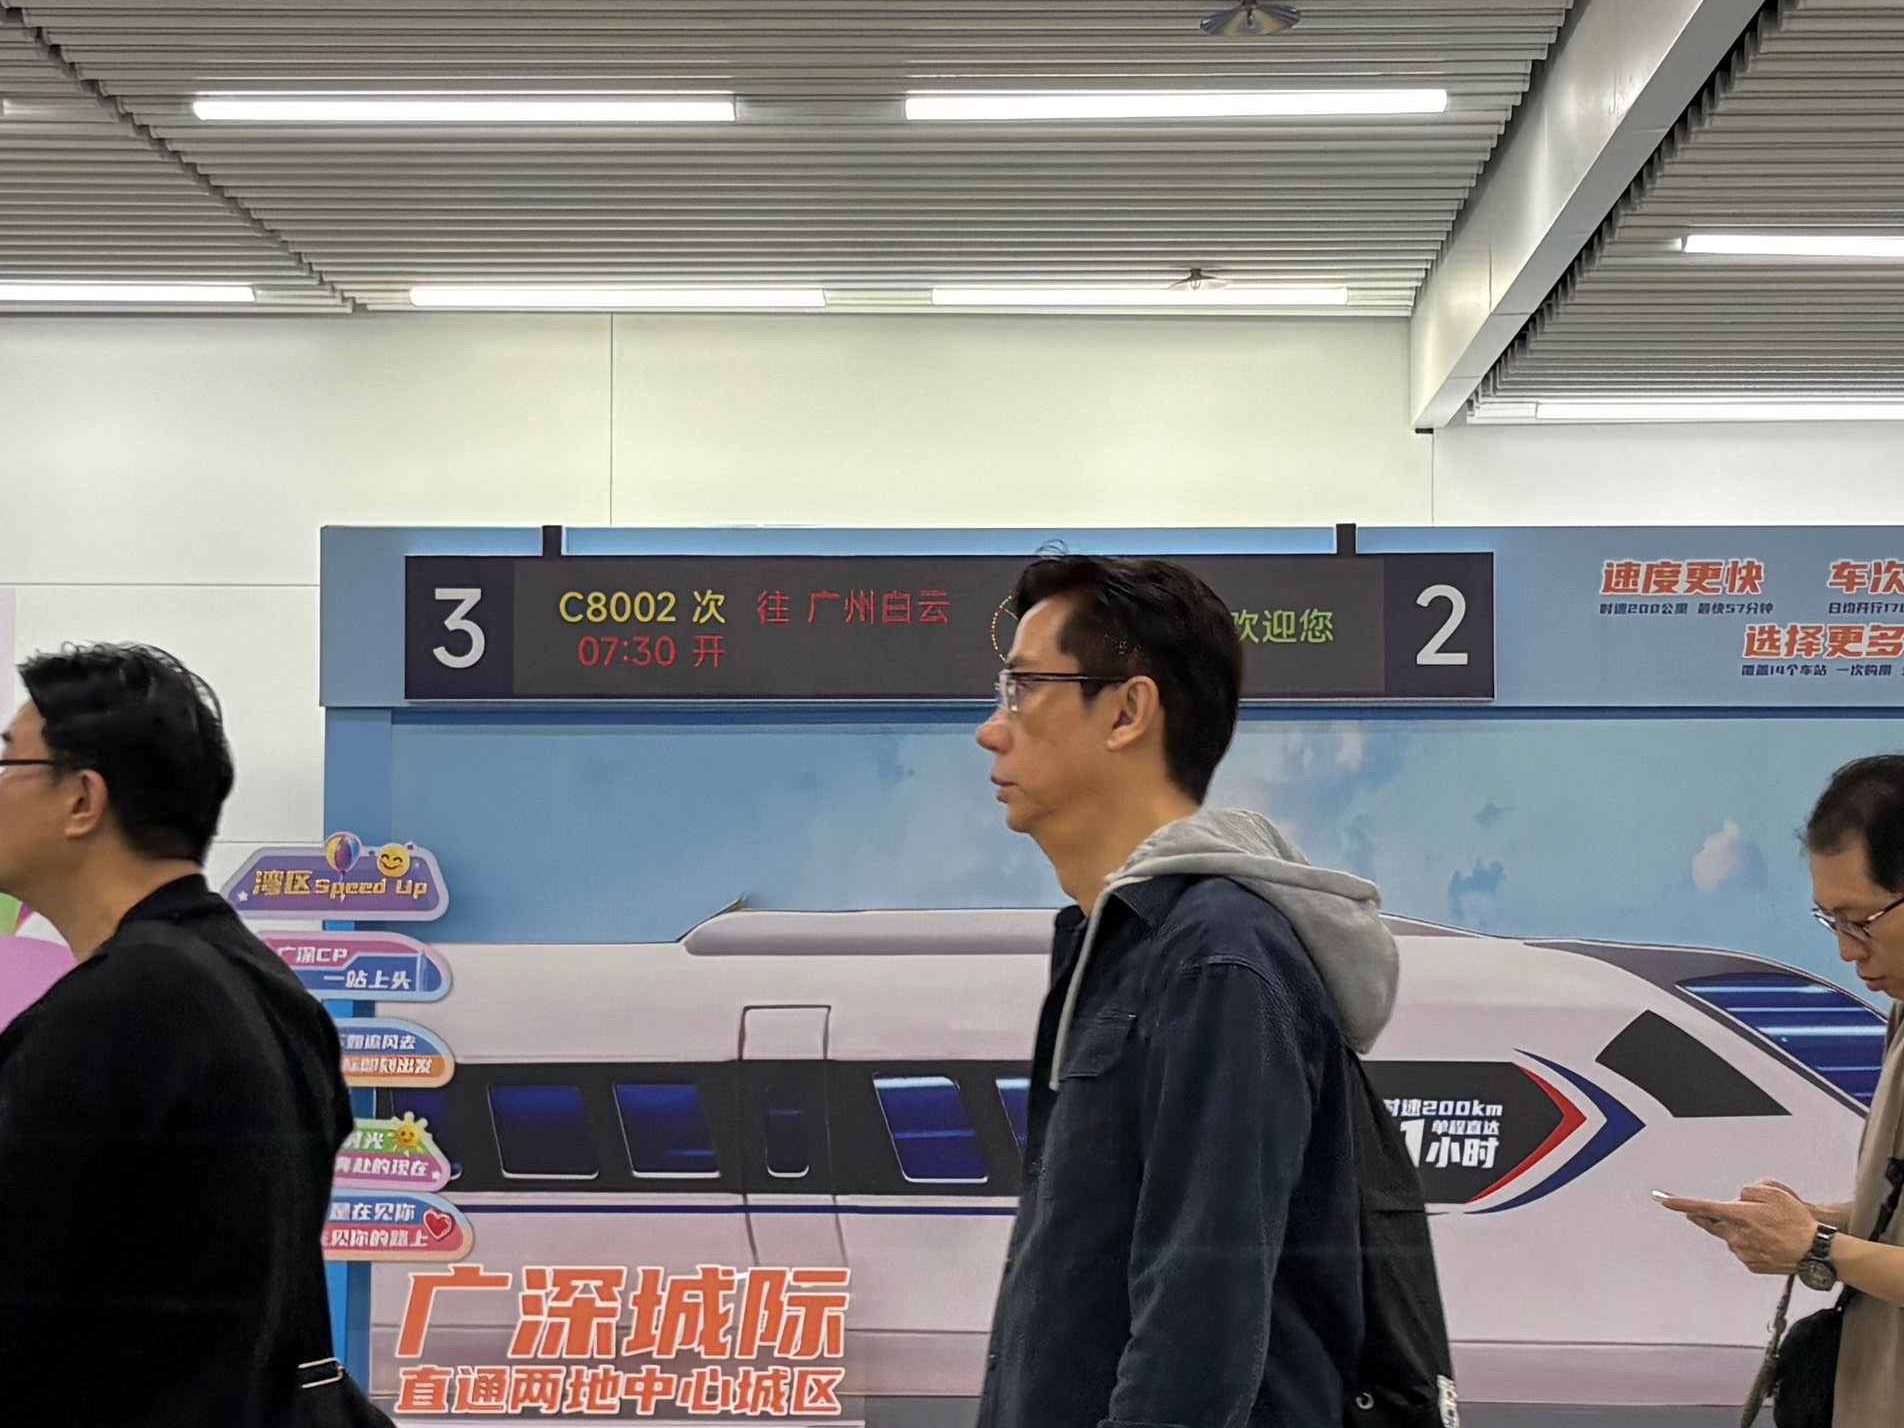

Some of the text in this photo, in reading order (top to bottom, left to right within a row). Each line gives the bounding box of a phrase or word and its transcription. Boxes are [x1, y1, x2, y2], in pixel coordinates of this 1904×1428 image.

[1601, 559, 1764, 594] 速度更快
[432, 587, 486, 669] 3
[559, 590, 950, 626] C8002 次 往 广州白云
[1414, 584, 1469, 666] 2
[577, 635, 726, 668] 07:30 开
[323, 969, 411, 990] 一站上头
[396, 1265, 850, 1359] 广深城际
[394, 1366, 844, 1416] 直通两地中心城区
